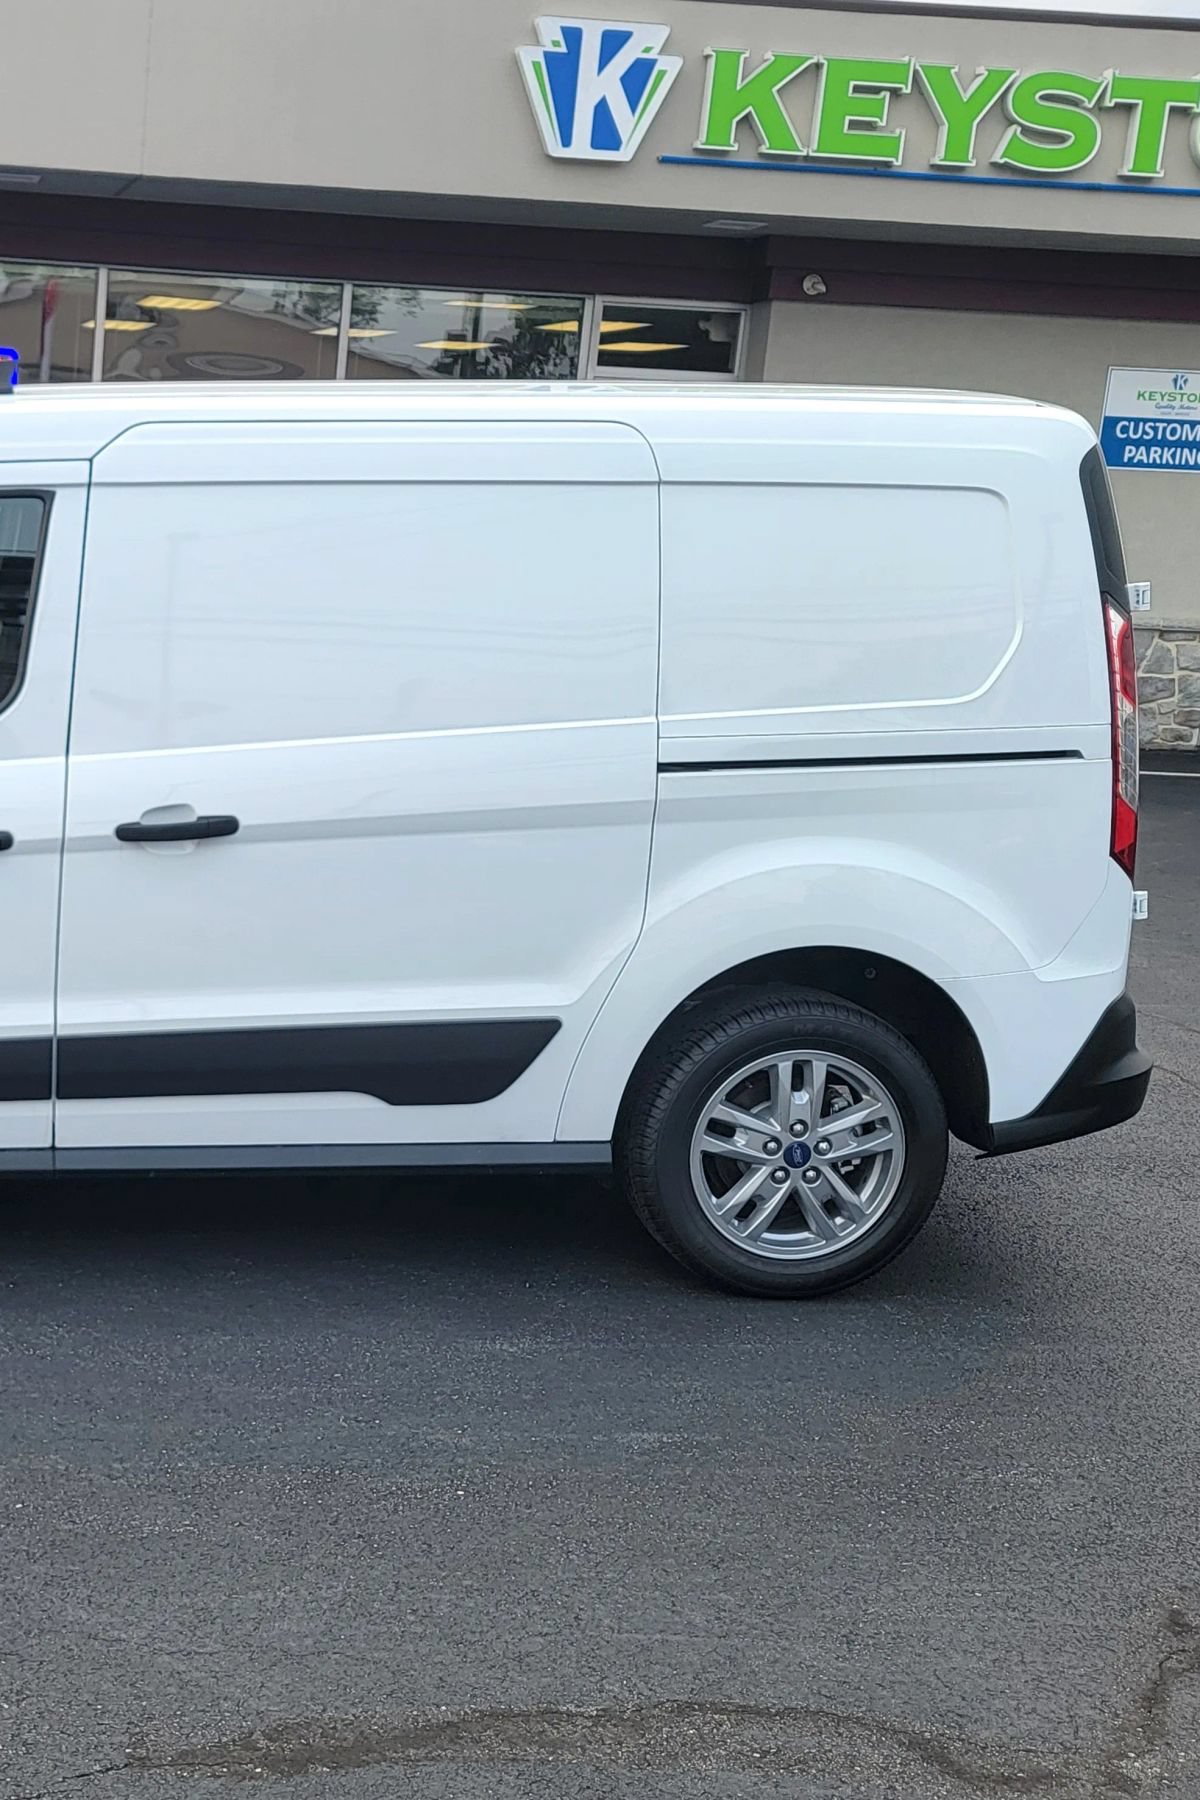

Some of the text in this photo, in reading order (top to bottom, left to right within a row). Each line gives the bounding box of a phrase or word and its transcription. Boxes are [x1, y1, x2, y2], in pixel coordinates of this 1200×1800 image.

[692, 47, 1200, 179] KEYST
[1136, 390, 1200, 403] KEYSTO
[1115, 421, 1200, 442] CUSTOM
[1123, 445, 1200, 466] PARKIN
